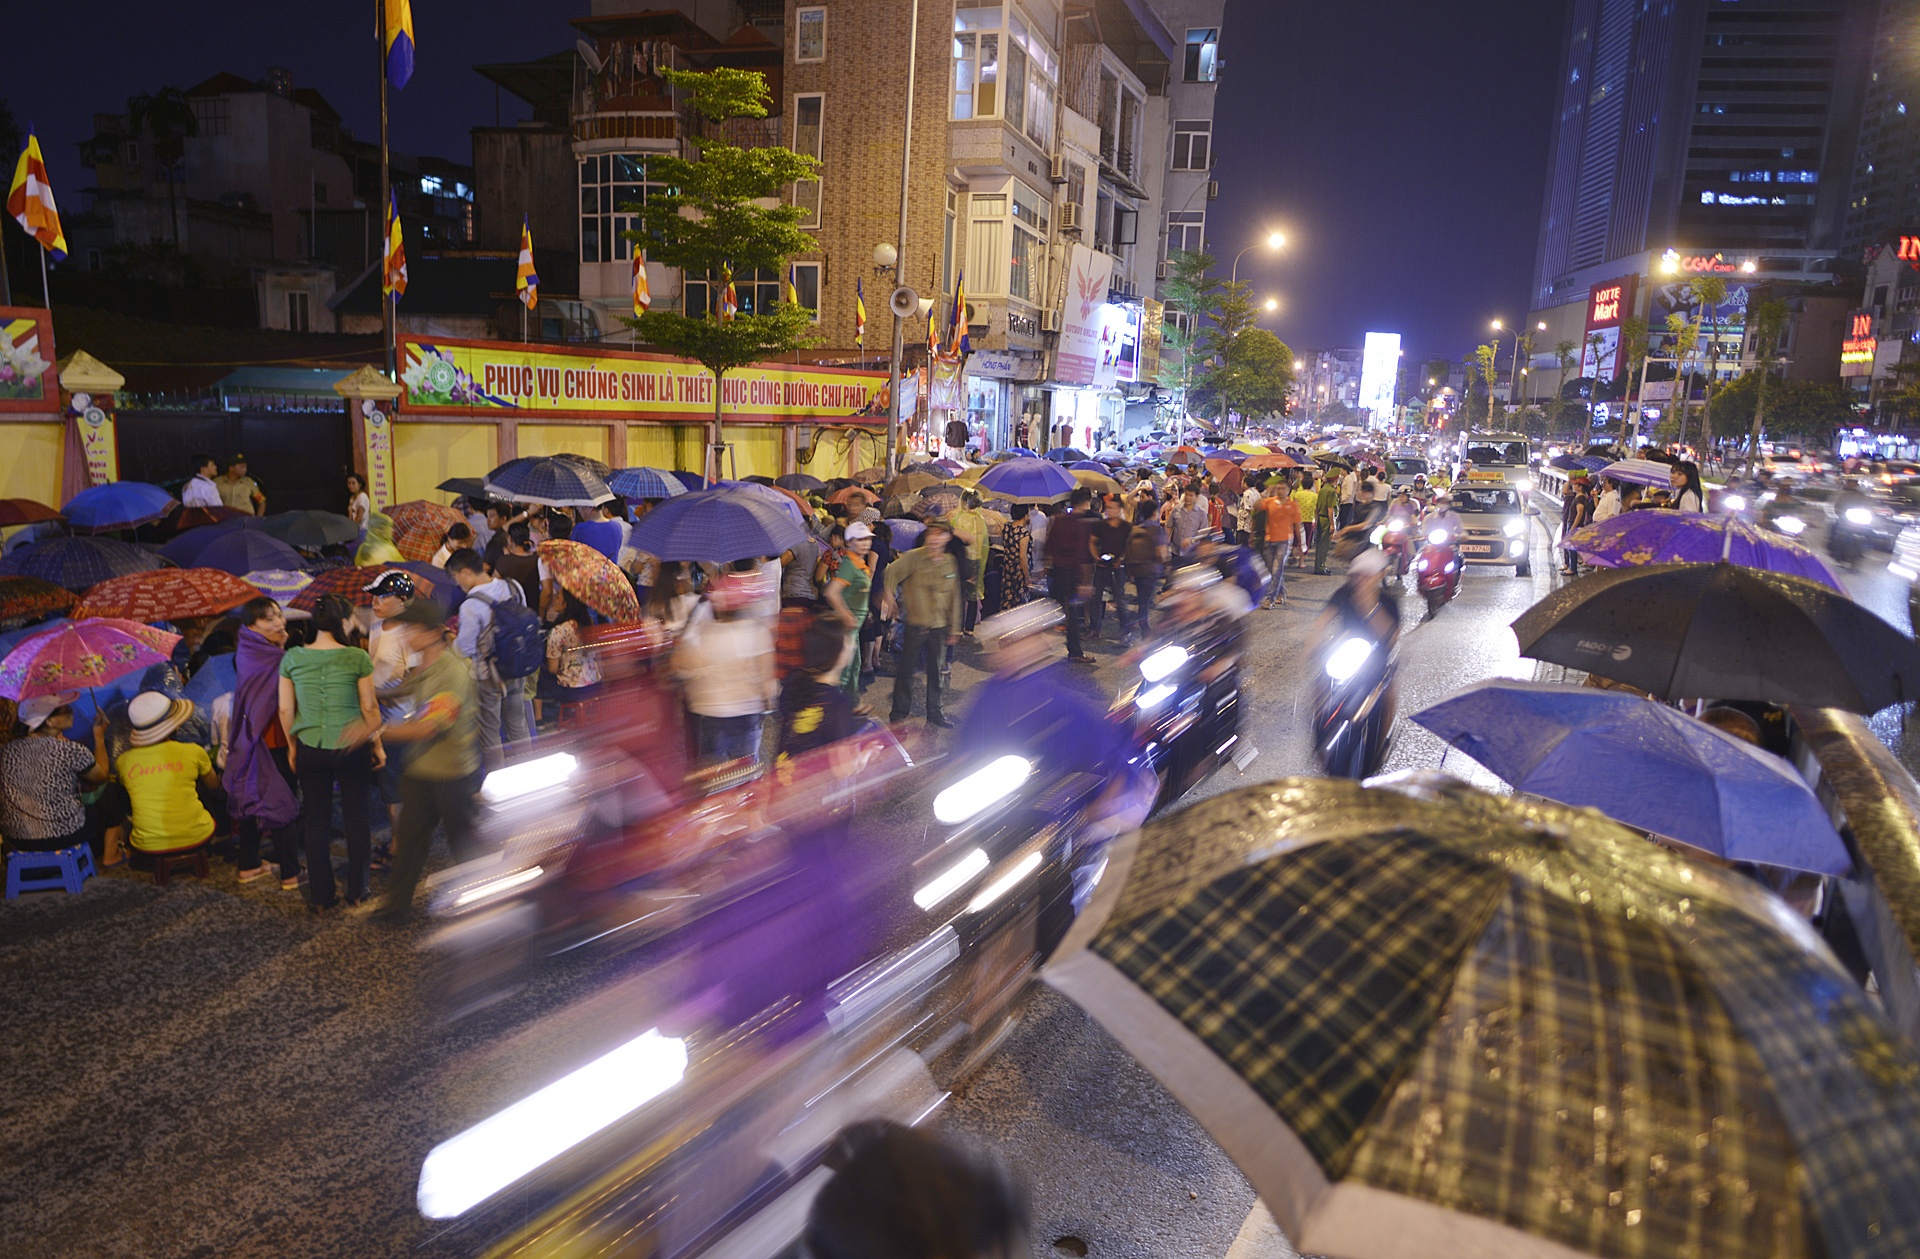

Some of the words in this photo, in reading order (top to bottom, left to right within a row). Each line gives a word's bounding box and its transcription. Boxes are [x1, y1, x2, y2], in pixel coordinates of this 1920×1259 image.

[1681, 256, 1716, 272] CGV
[1596, 286, 1621, 303] LOTTE
[1593, 300, 1619, 322] Mart
[1852, 314, 1871, 336] IN
[484, 364, 533, 404] PHỤC
[537, 368, 560, 405] VỤ
[564, 365, 618, 400] CHÚNG
[621, 372, 656, 401] SINH
[659, 369, 675, 402] LÀ
[677, 371, 713, 403] THIẾT
[721, 377, 748, 410] HỰC
[750, 376, 781, 406] CÚNG
[821, 383, 842, 408] CHƯ
[843, 383, 868, 414] PHẬT
